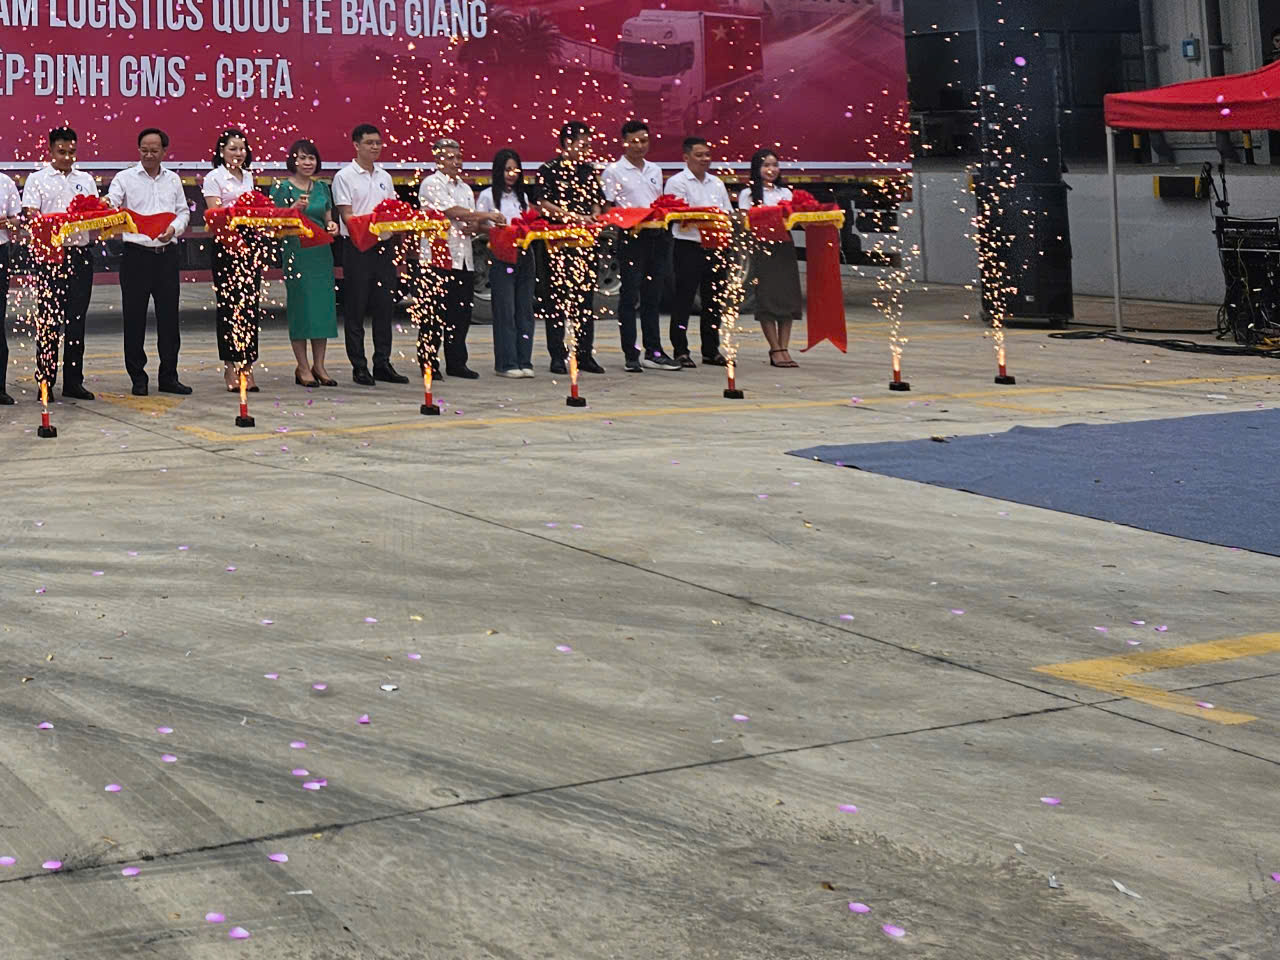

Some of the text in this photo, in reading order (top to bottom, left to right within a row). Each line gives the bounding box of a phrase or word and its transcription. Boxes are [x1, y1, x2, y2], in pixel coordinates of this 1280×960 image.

[33, 53, 110, 105] ĐỊNH
[119, 55, 186, 98] GMS
[216, 56, 293, 99] CBTA
